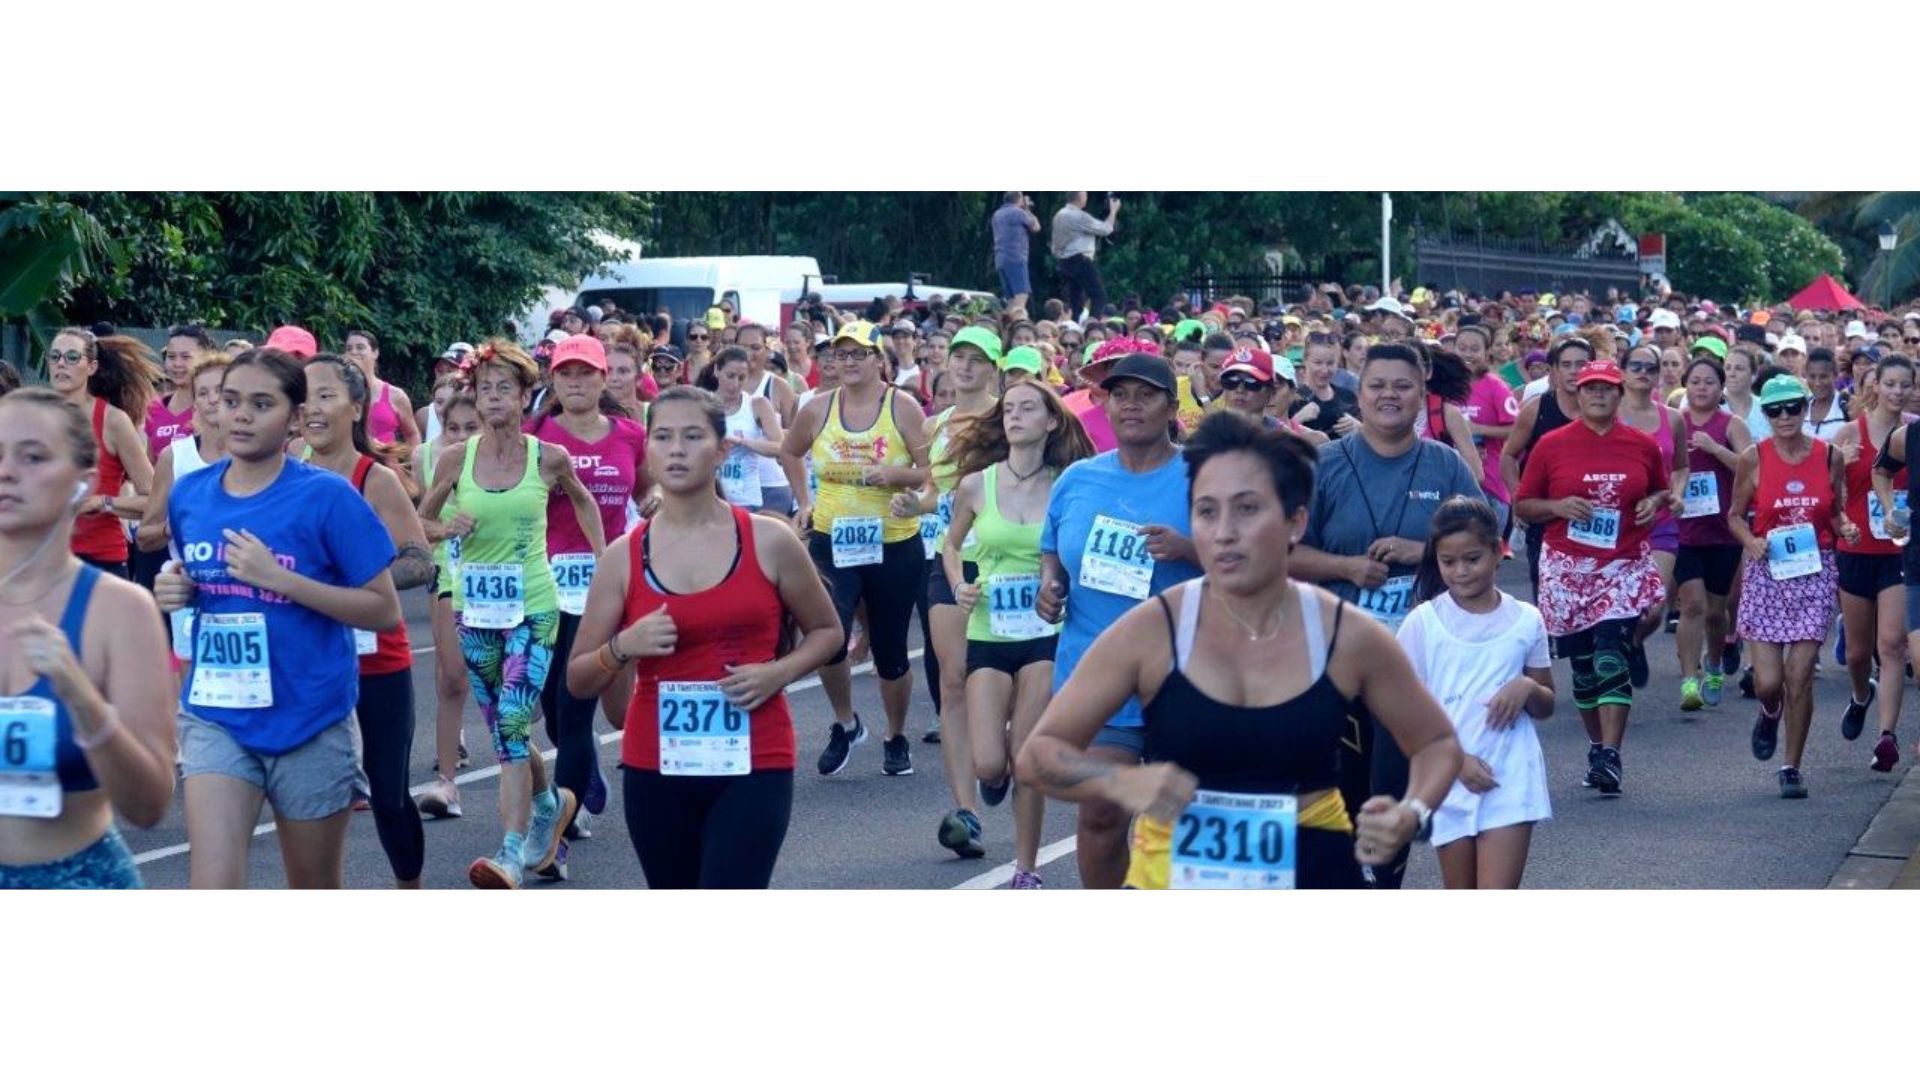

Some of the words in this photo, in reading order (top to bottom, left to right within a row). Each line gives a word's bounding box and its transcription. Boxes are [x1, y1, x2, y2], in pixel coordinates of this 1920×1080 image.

[156, 424, 180, 437] EDT
[570, 455, 602, 469] EDT
[1582, 473, 1627, 481] ASCEP
[1774, 497, 1819, 508] ASCEP
[834, 525, 878, 544] 2087
[1090, 529, 1150, 565] 1184
[1784, 536, 1796, 554] 6
[465, 575, 518, 599] 1436
[201, 631, 261, 665] 2905
[662, 699, 741, 732] 2376
[1178, 814, 1284, 864] 2310
